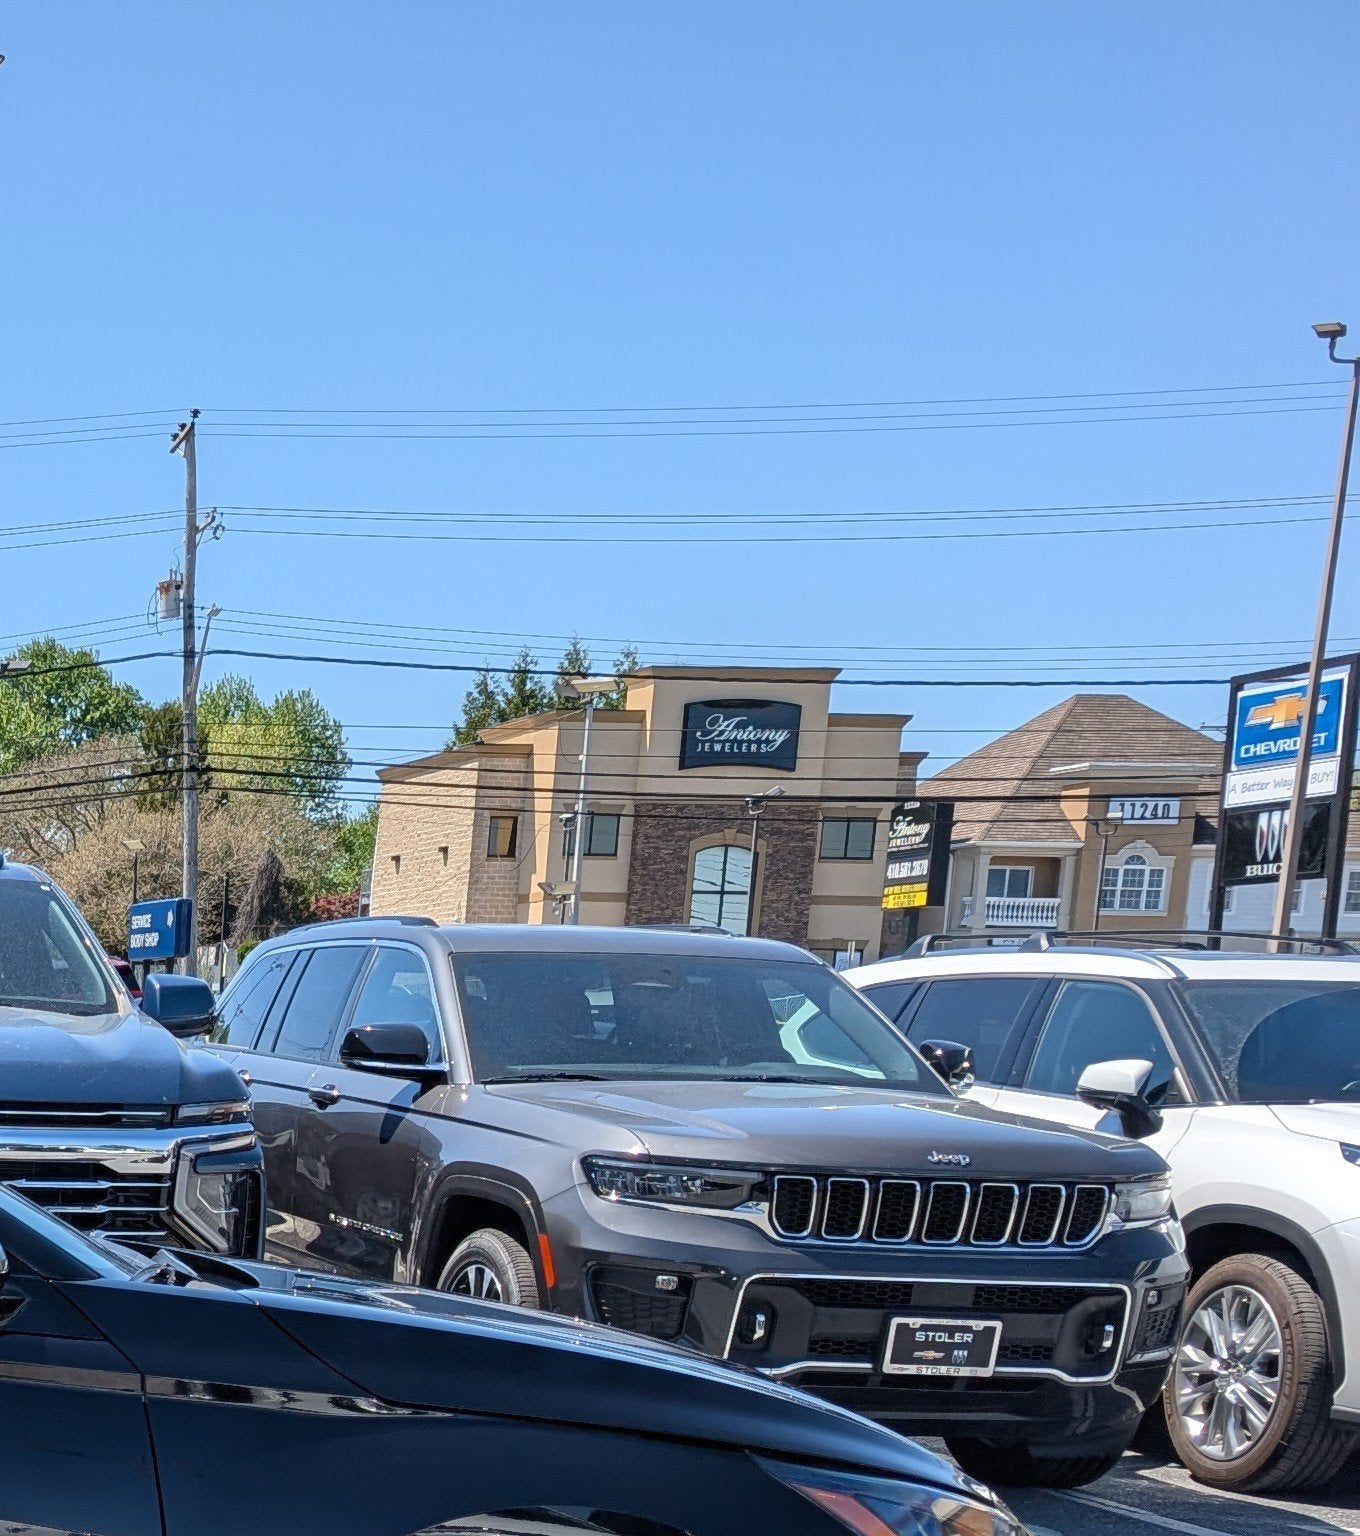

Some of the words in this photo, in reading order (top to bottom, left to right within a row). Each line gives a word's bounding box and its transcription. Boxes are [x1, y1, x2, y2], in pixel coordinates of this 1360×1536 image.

[695, 713, 791, 752] Antony
[696, 742, 769, 753] JEWELERS
[1240, 731, 1329, 758] CHEVROET
[1229, 784, 1237, 794] A
[1241, 779, 1271, 794] Better
[1245, 862, 1284, 877] BUIC
[927, 1150, 971, 1166] Jeep
[914, 1331, 975, 1344] STOLER
[915, 1366, 961, 1375] STOLER
